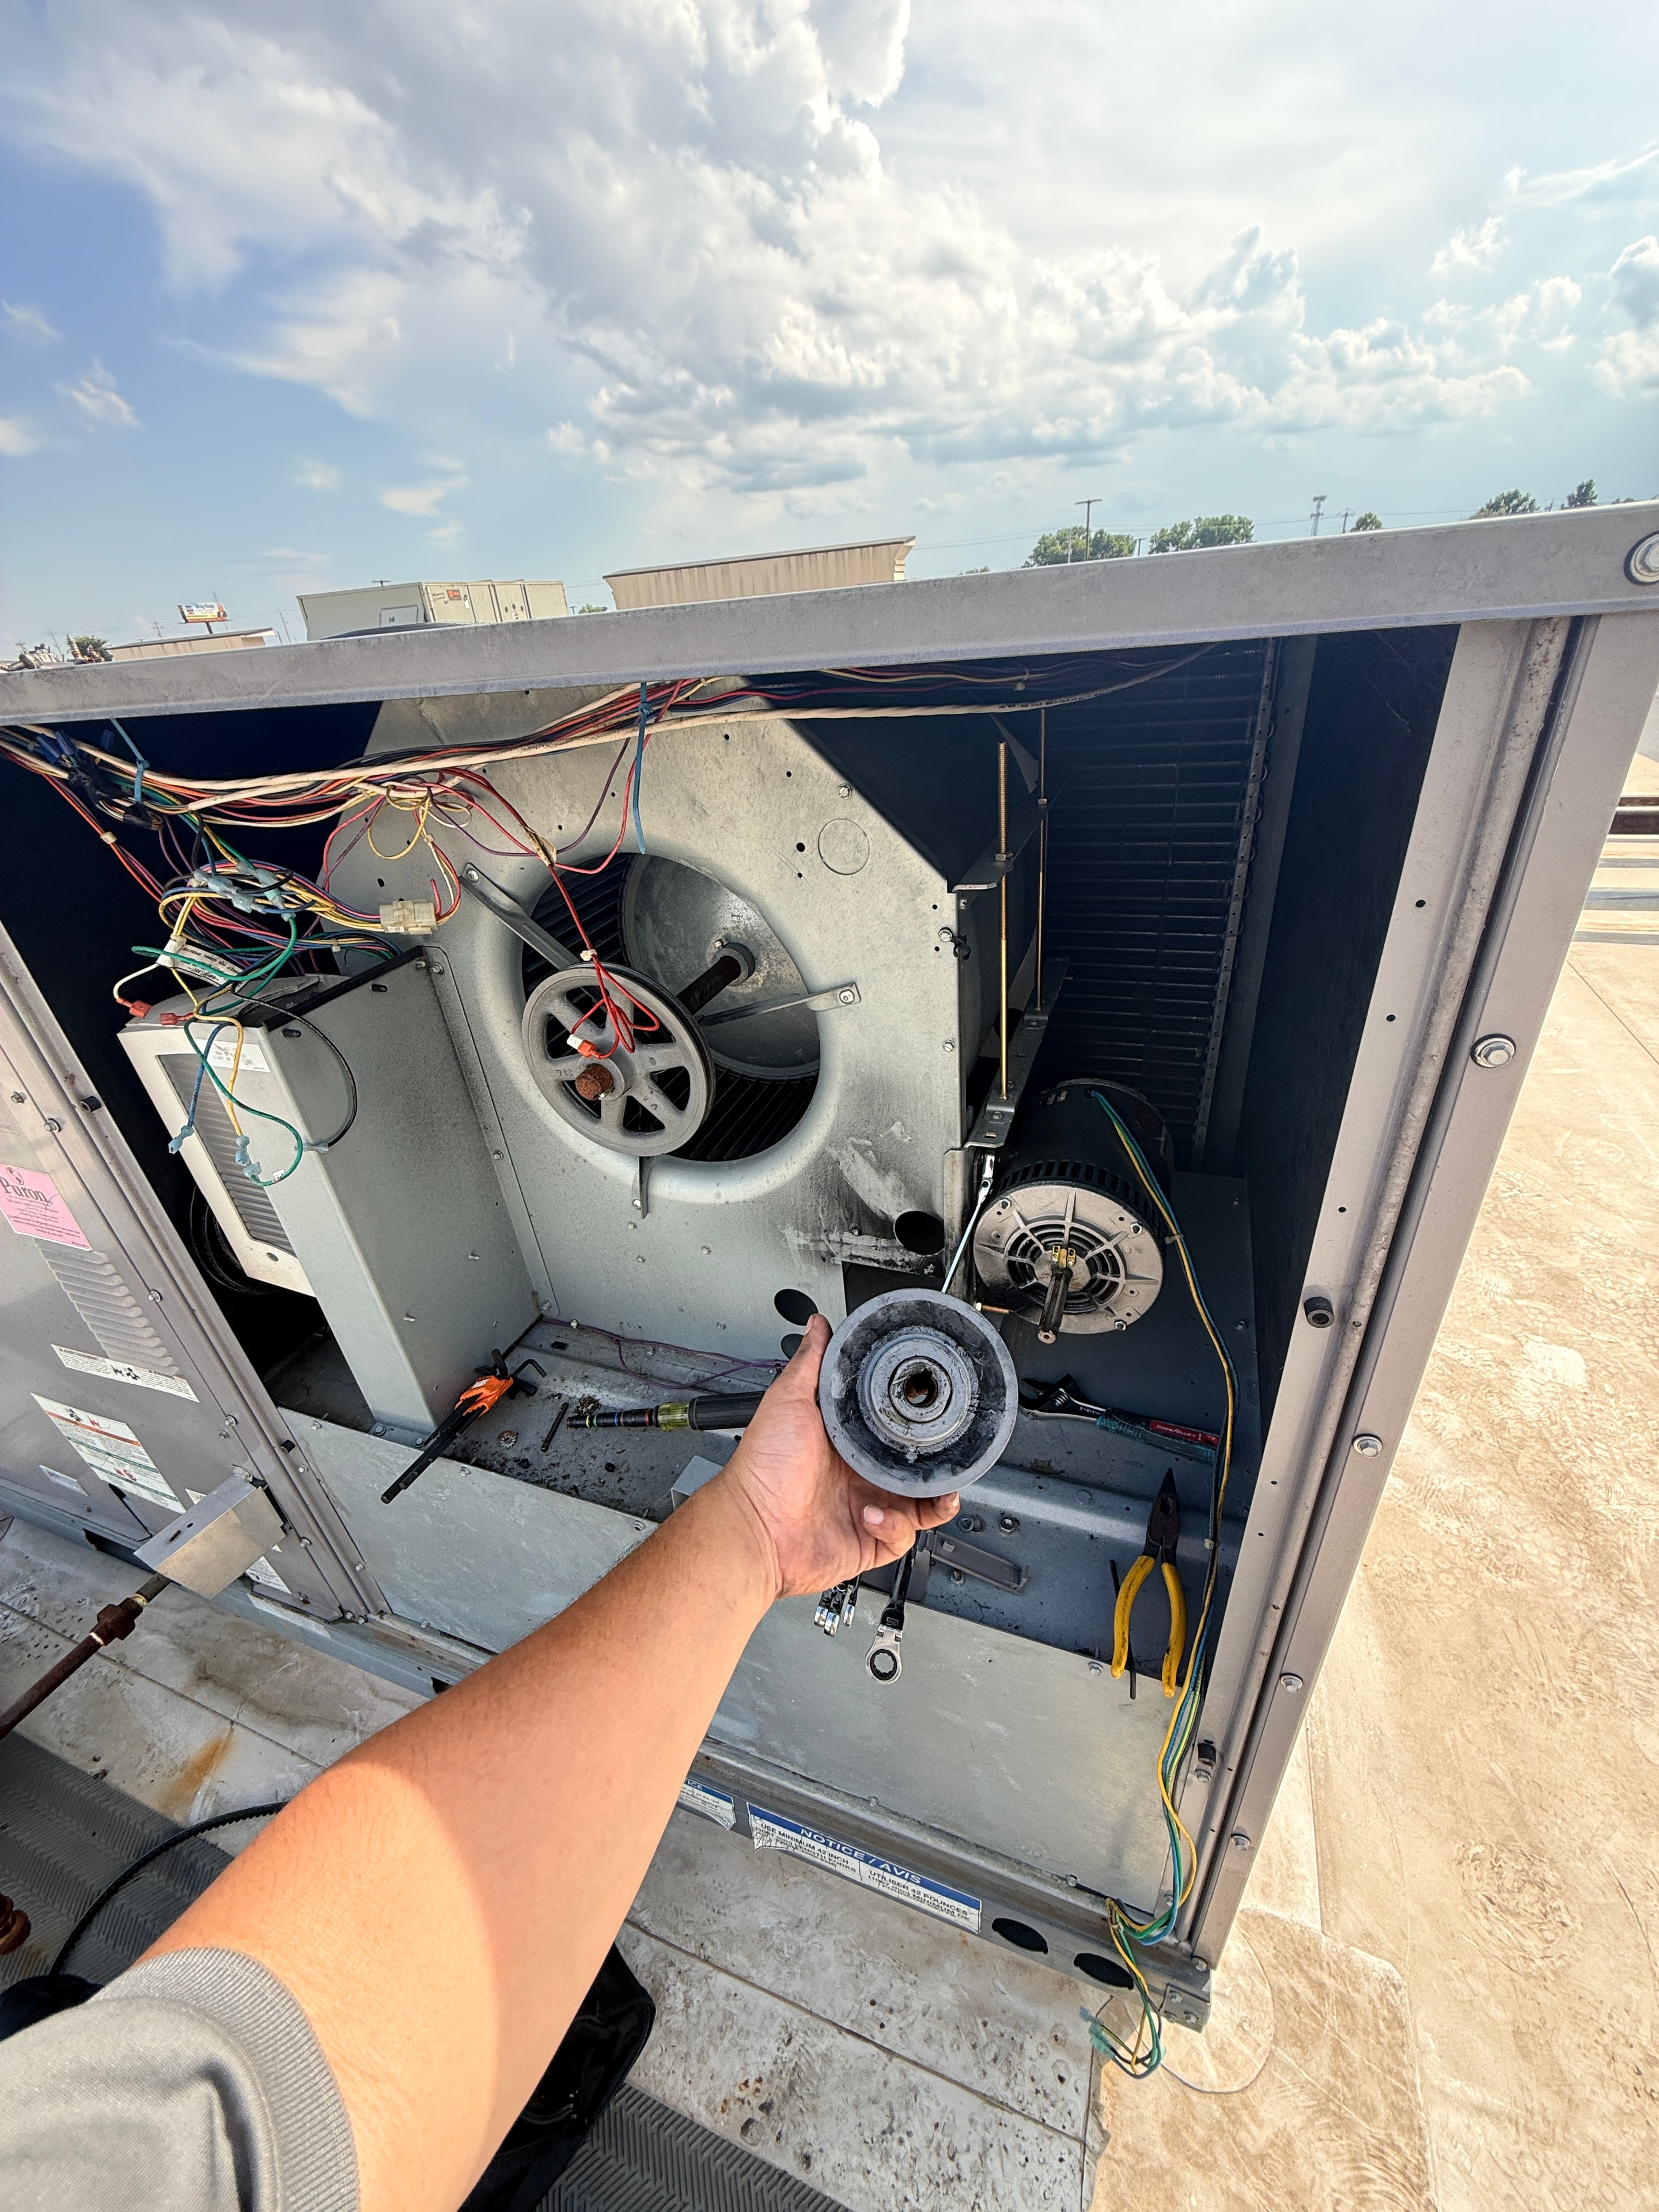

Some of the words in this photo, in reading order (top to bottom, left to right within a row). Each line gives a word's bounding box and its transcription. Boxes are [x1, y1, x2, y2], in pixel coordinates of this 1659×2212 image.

[0, 1177, 49, 1203] Puron
[760, 1823, 777, 1834] USE
[778, 1830, 815, 1850] MINIMUM
[828, 1852, 849, 1865] INCH
[800, 1828, 865, 1861] NOTICE
[879, 1863, 922, 1884] AVIS
[828, 1857, 857, 1873] FORKS
[869, 1870, 908, 1890] UTILISER
[912, 1893, 955, 1915] MINIMUM
[957, 1912, 970, 1922] DE
